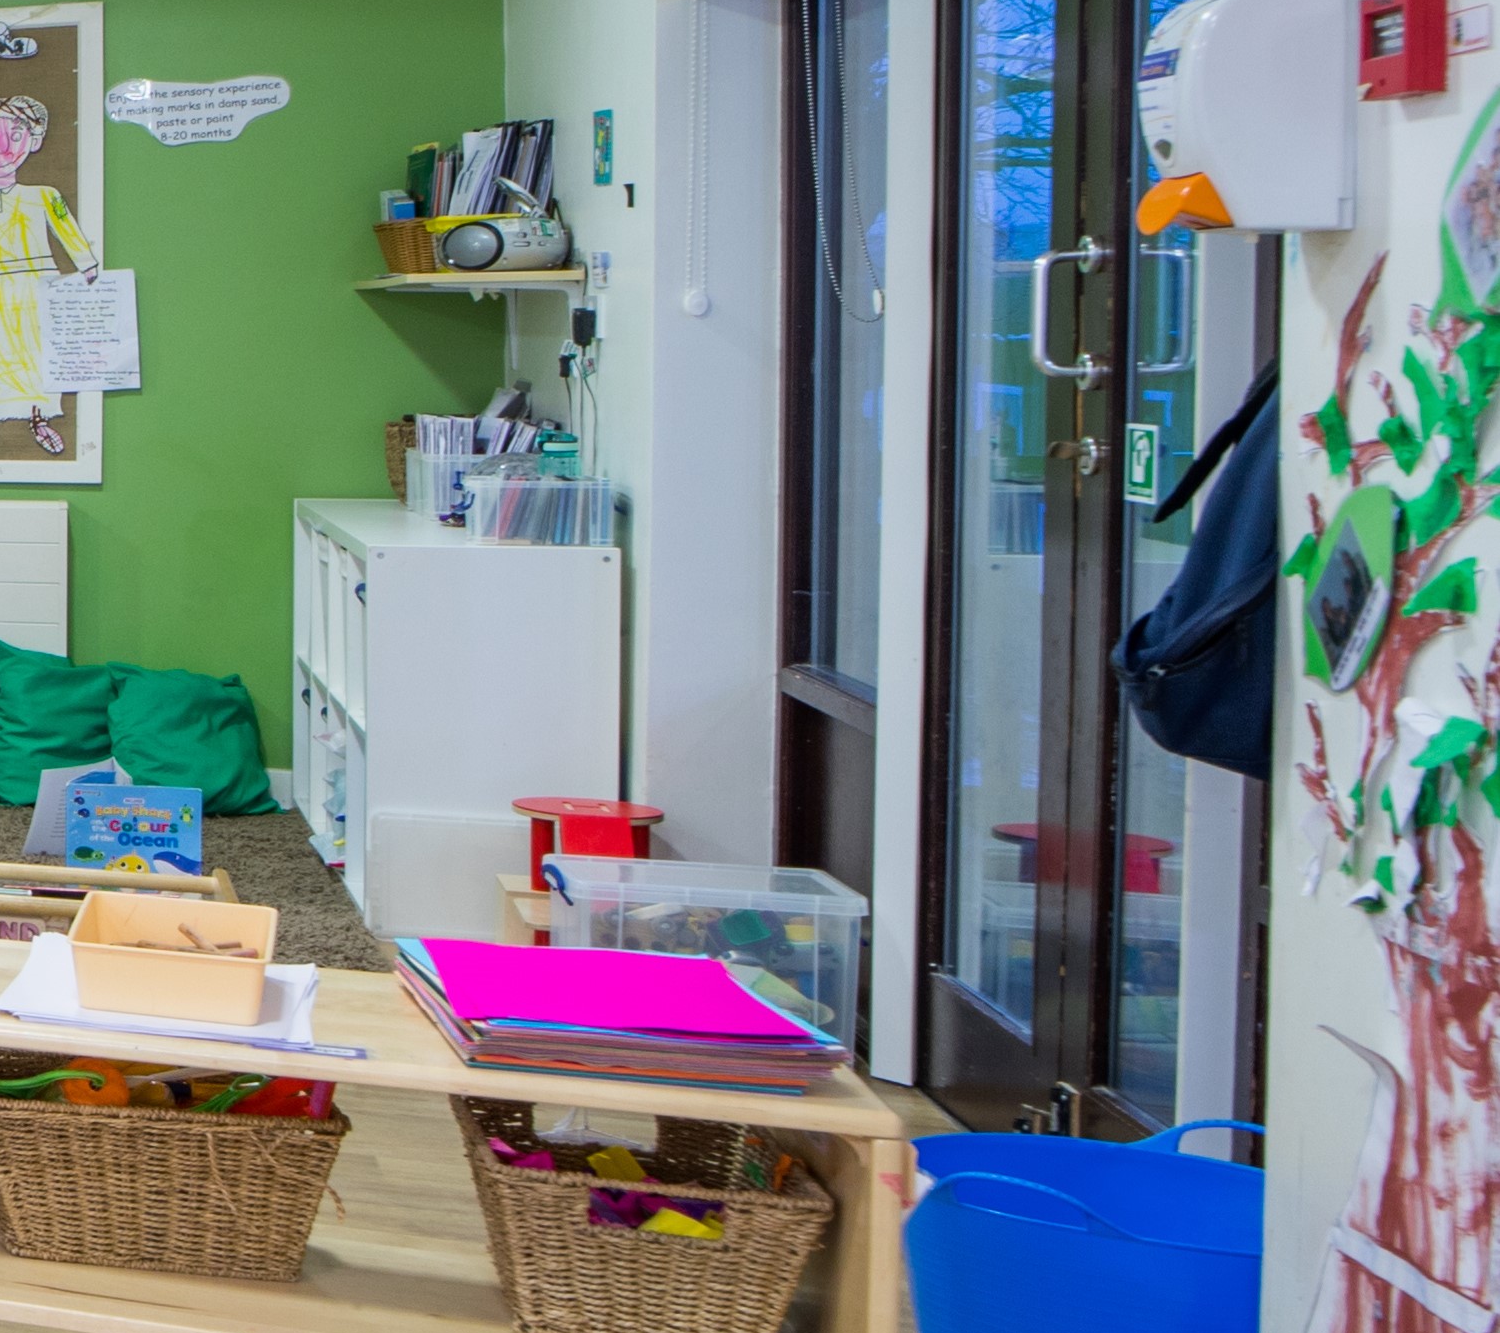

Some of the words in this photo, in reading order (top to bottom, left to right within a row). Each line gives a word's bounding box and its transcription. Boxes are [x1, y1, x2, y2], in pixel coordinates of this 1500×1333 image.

[172, 87, 215, 99] sensory
[218, 81, 282, 96] experience
[126, 107, 164, 117] making
[168, 102, 201, 114] marks
[205, 100, 215, 109] in
[219, 98, 247, 111] damp
[156, 118, 188, 129] paste
[190, 117, 202, 126] or
[206, 114, 234, 126] paint
[160, 130, 188, 141] 8-20
[191, 128, 232, 139] months
[95, 807, 128, 817] Baby
[132, 806, 172, 820] Shark
[109, 817, 179, 833] Colours
[118, 832, 179, 848] Ocean
